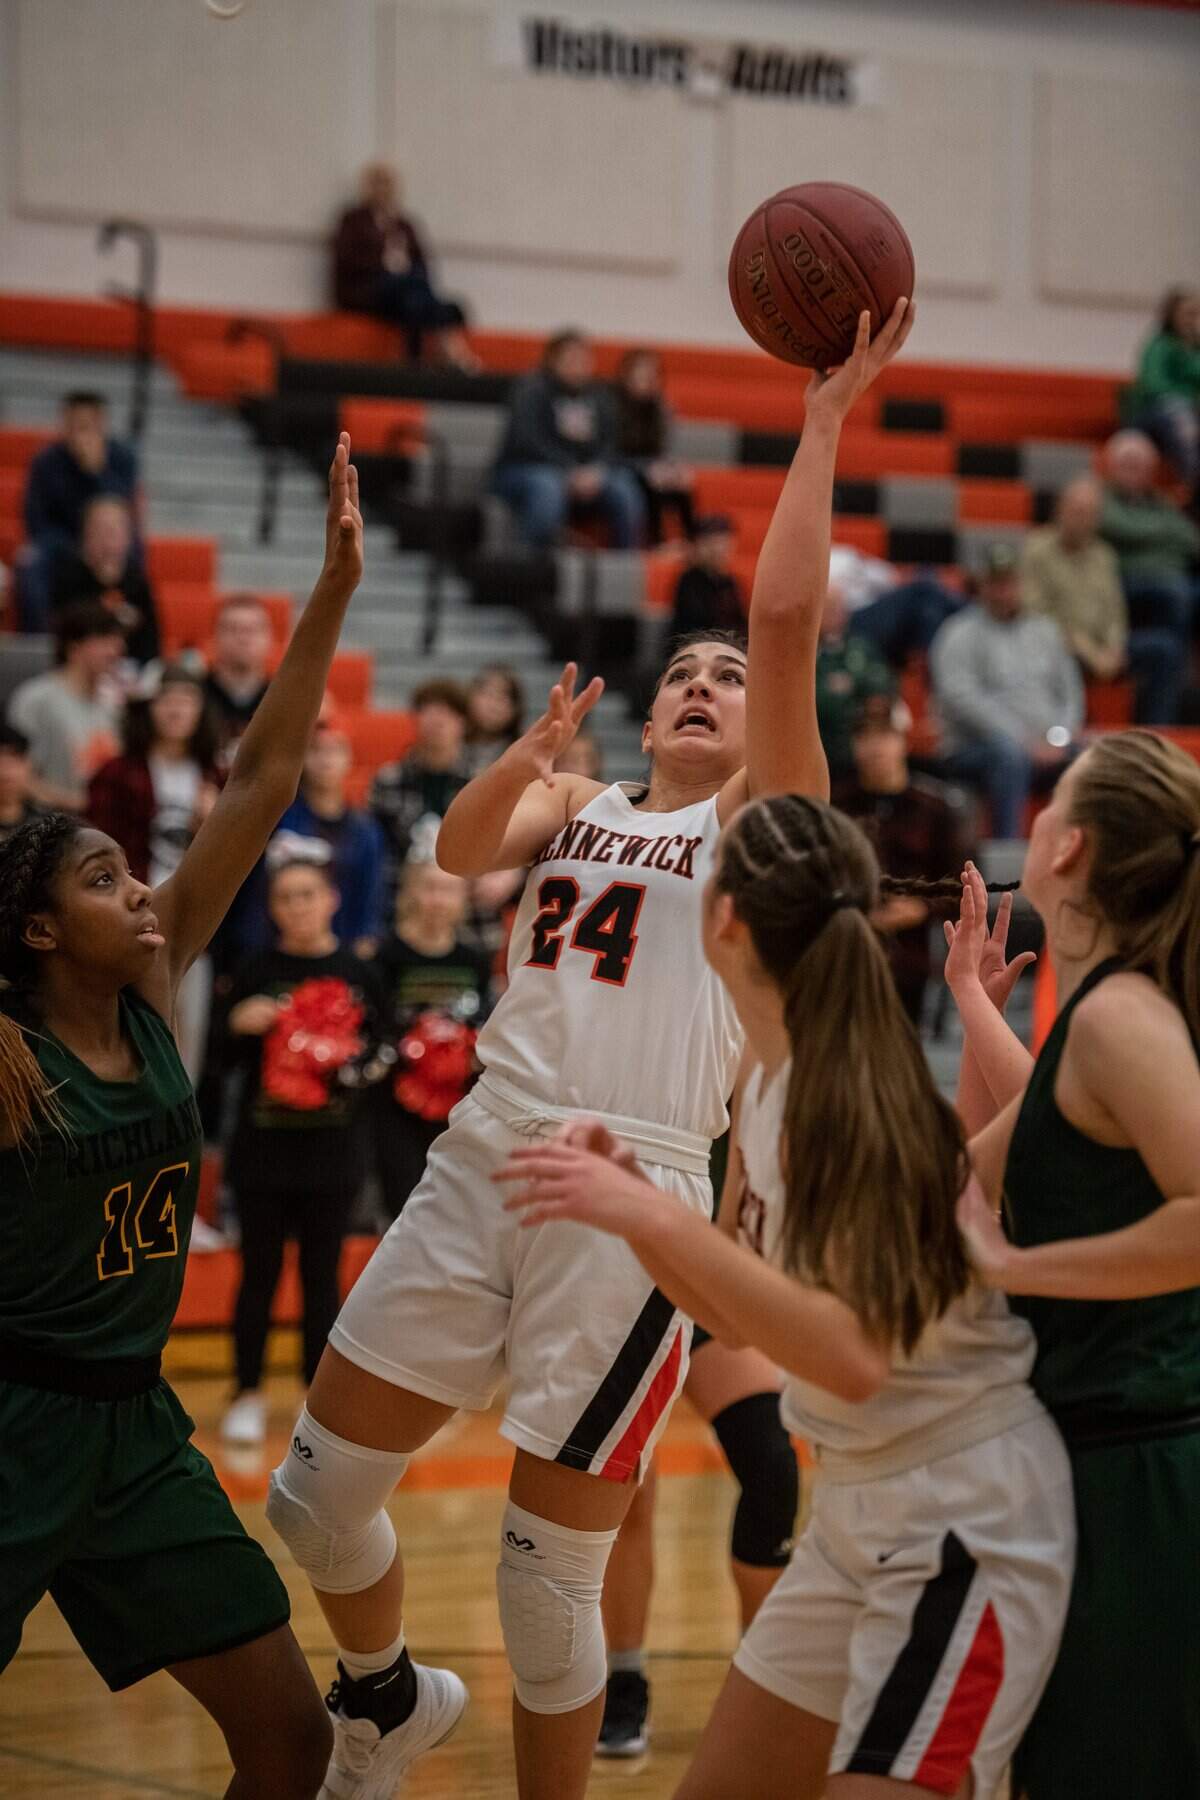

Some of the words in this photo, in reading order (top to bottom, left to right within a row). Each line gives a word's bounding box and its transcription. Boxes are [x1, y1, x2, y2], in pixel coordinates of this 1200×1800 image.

[783, 232, 836, 300] 1000
[533, 820, 702, 880] ENNEWICK
[522, 876, 647, 987] 24
[97, 1161, 189, 1280] 14
